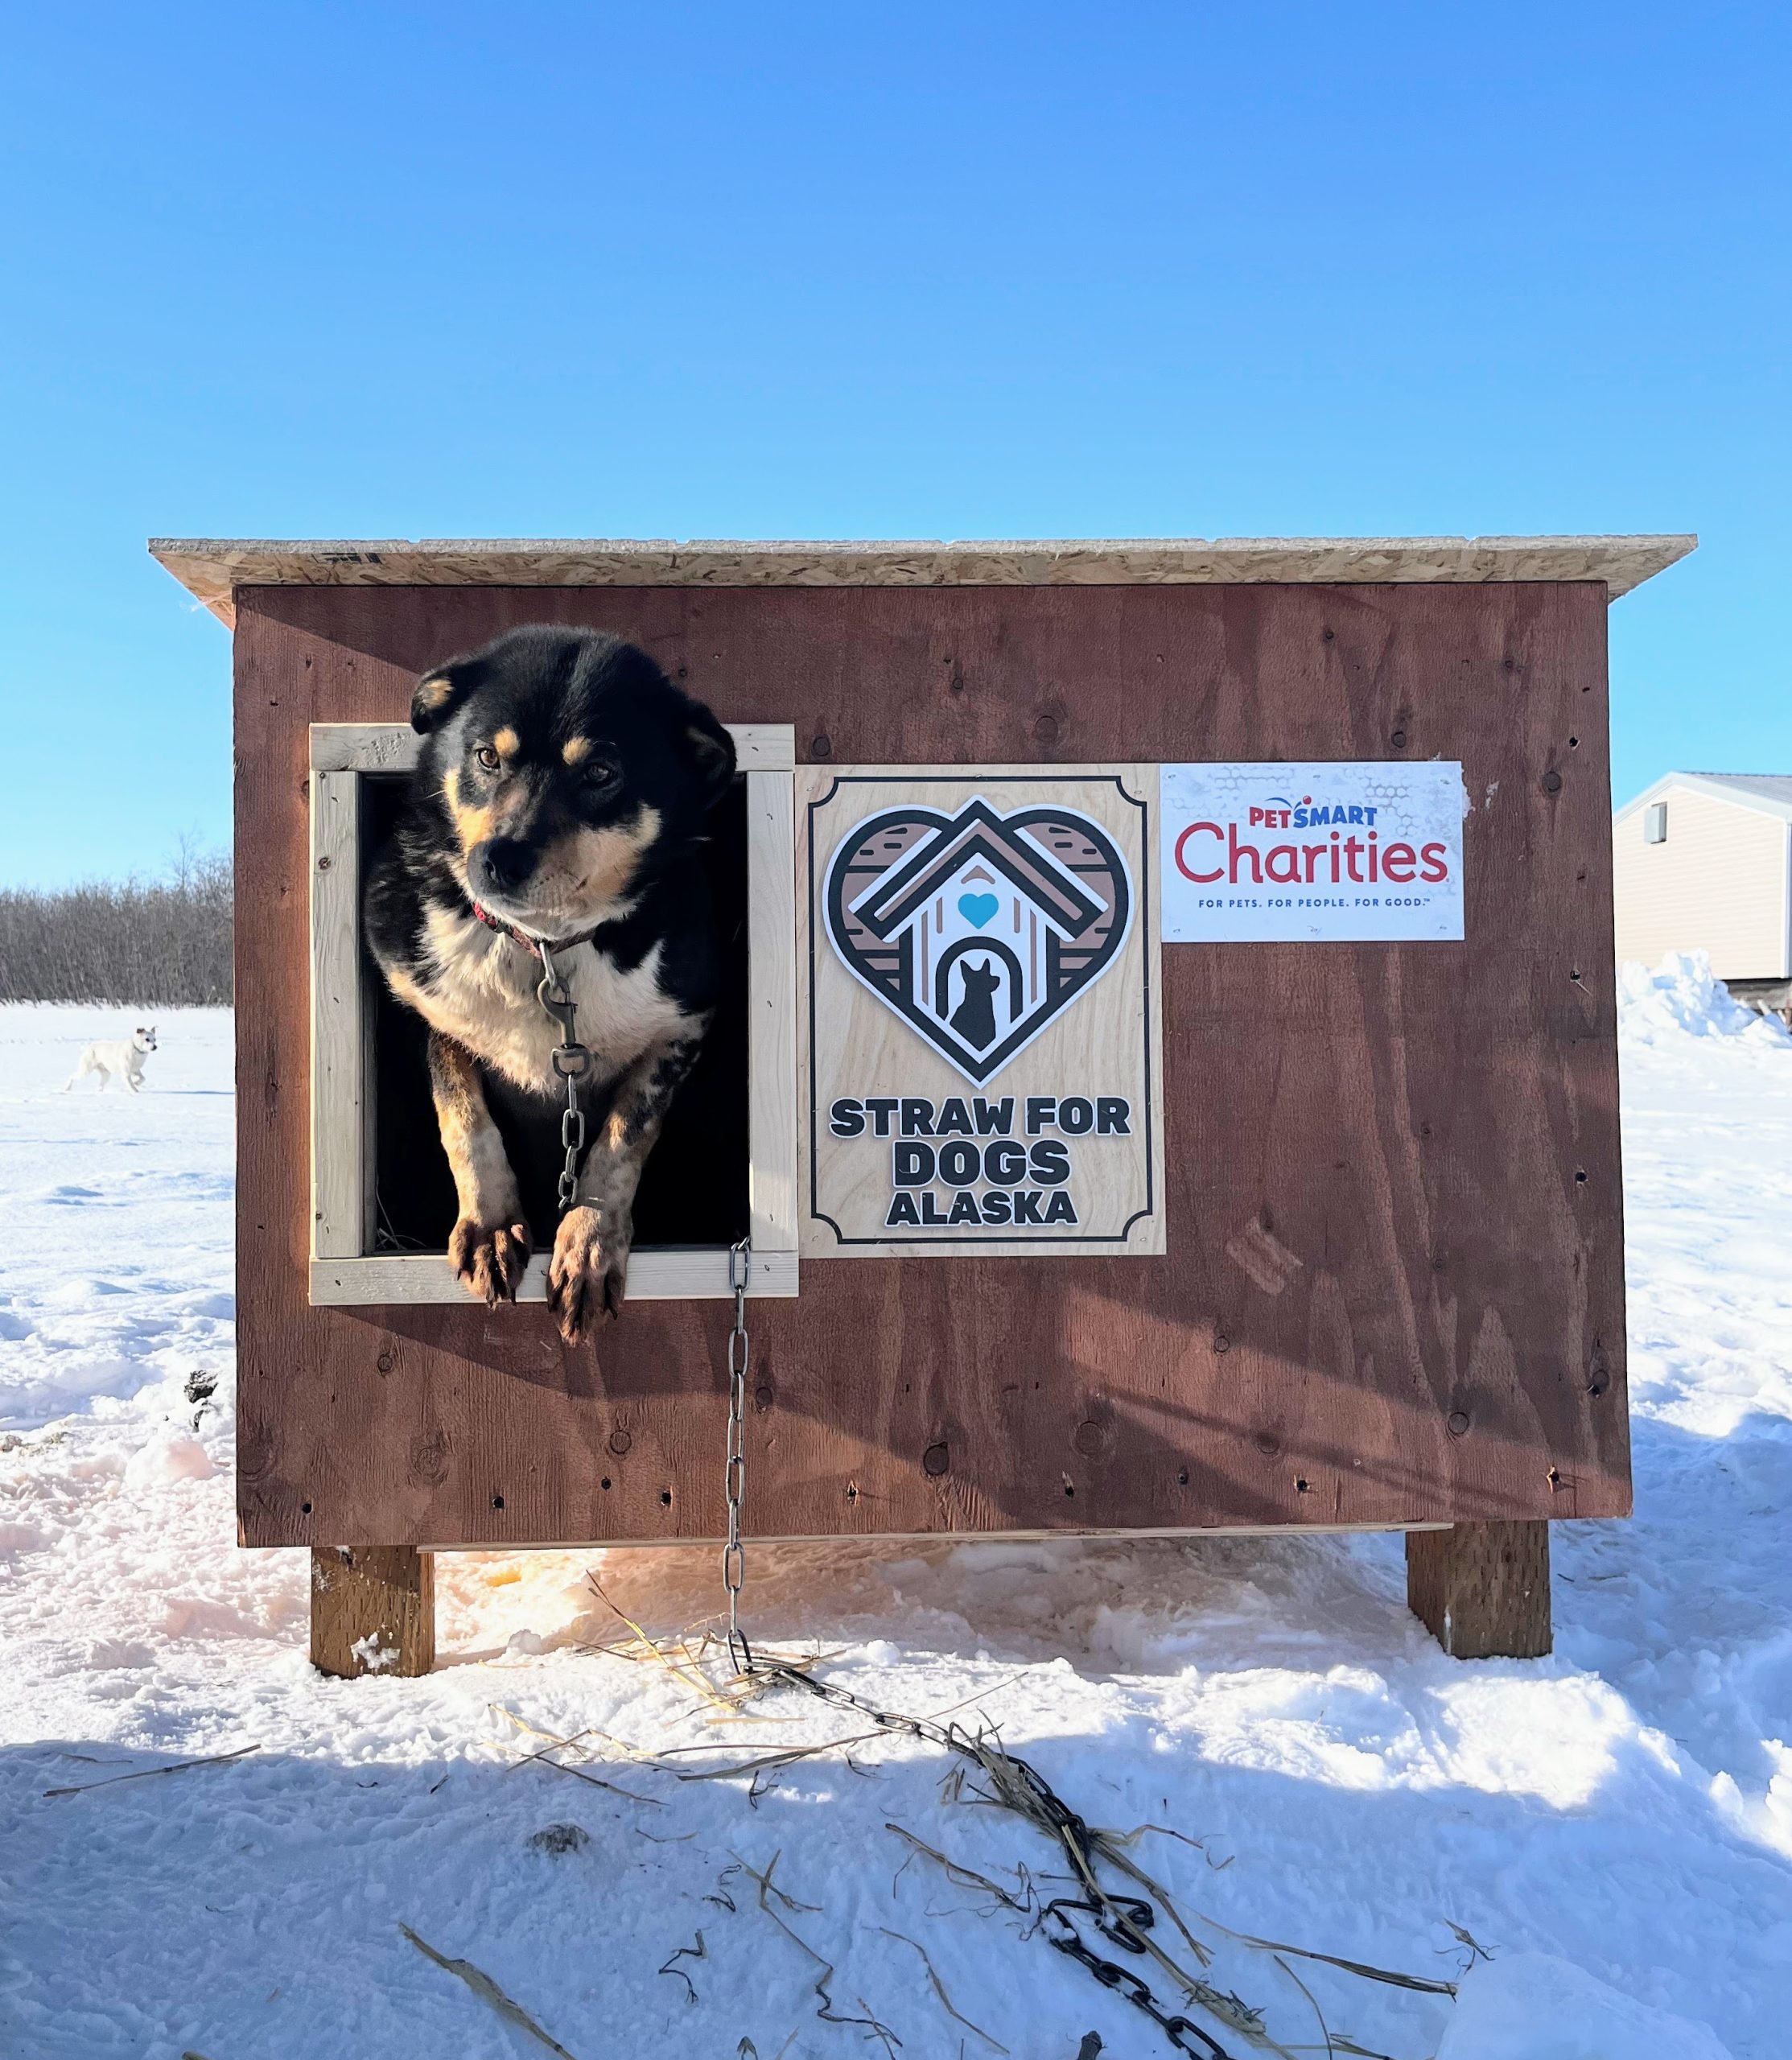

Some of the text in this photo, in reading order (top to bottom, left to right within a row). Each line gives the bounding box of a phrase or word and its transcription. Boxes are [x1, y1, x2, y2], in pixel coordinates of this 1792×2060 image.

[1249, 805, 1378, 829] PETSMART
[1174, 822, 1448, 884] Charities
[1198, 899, 1223, 908] FOR
[1229, 899, 1263, 908] PETS.
[1267, 899, 1292, 908] FOR
[1298, 898, 1349, 908] PEOPLE.
[1355, 898, 1379, 907] FOR
[830, 1097, 1131, 1136] STRAW FOR
[893, 1139, 1071, 1186] DOGS
[885, 1191, 1078, 1226] ALASKA
